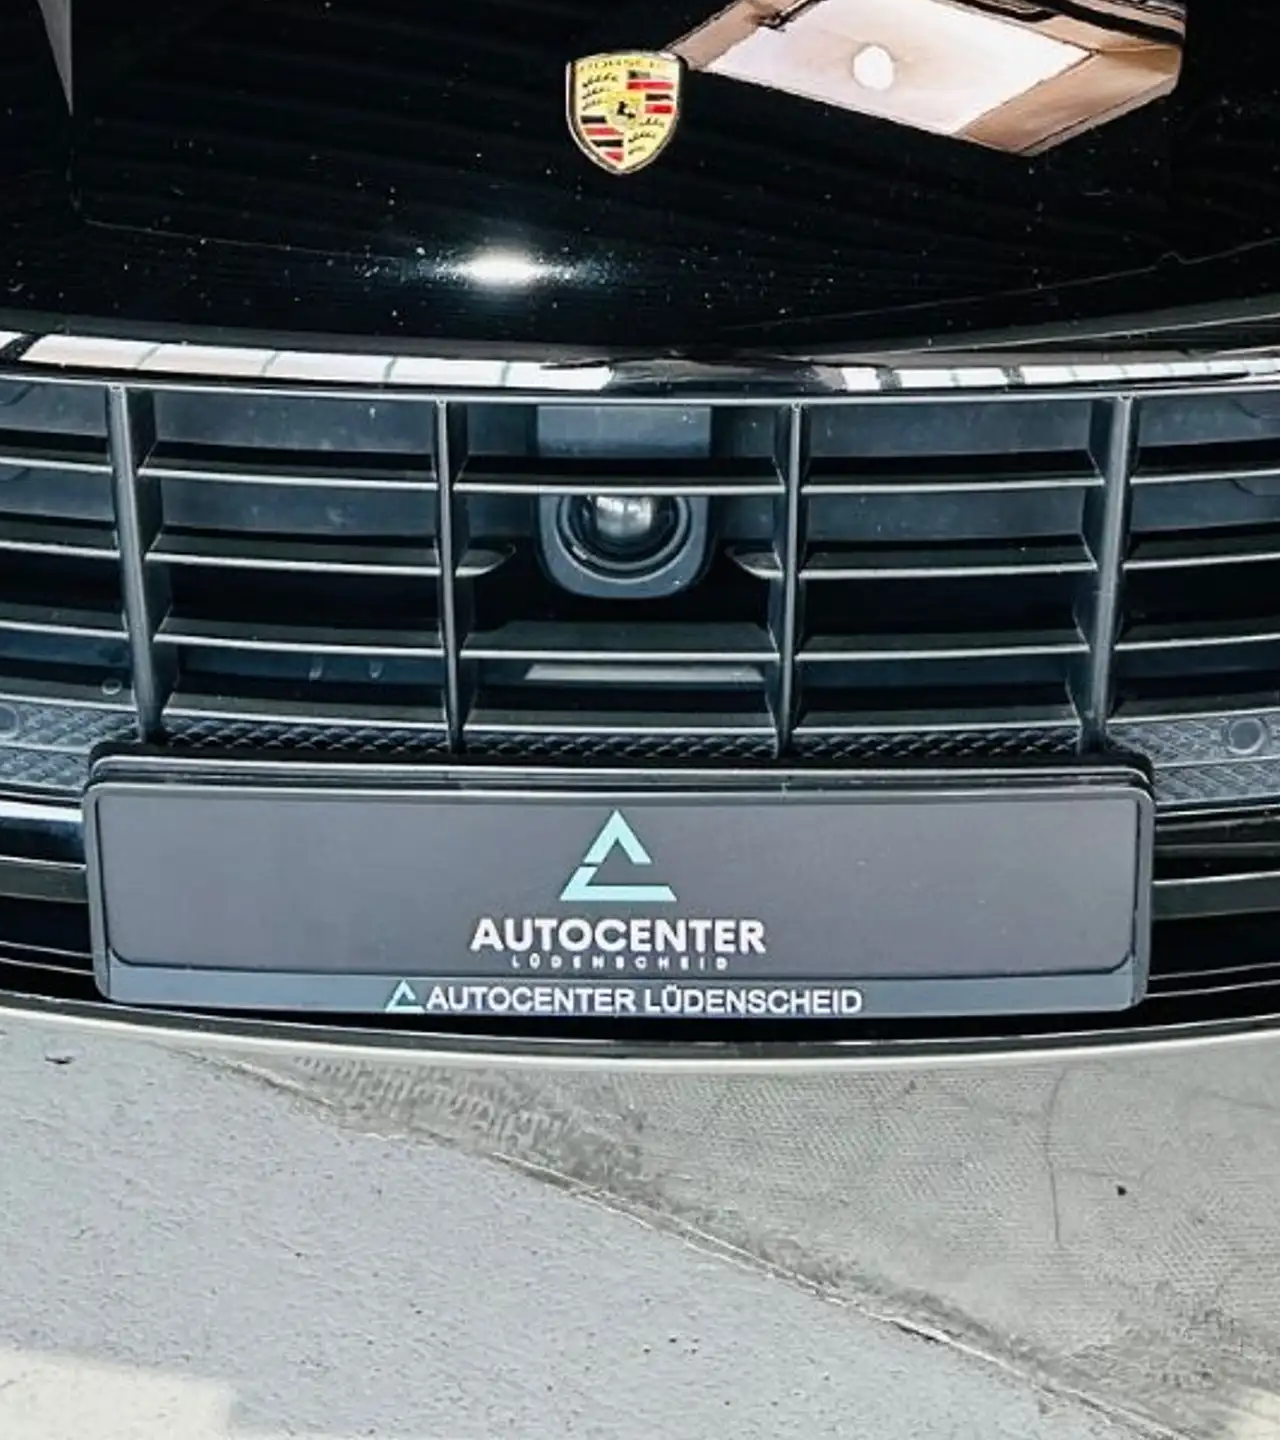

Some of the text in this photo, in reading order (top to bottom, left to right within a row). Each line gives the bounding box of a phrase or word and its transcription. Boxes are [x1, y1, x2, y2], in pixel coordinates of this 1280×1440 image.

[469, 917, 768, 954] AUTOCENTER
[425, 983, 864, 1015] AUTOCENTER LÜDENSCHEID
